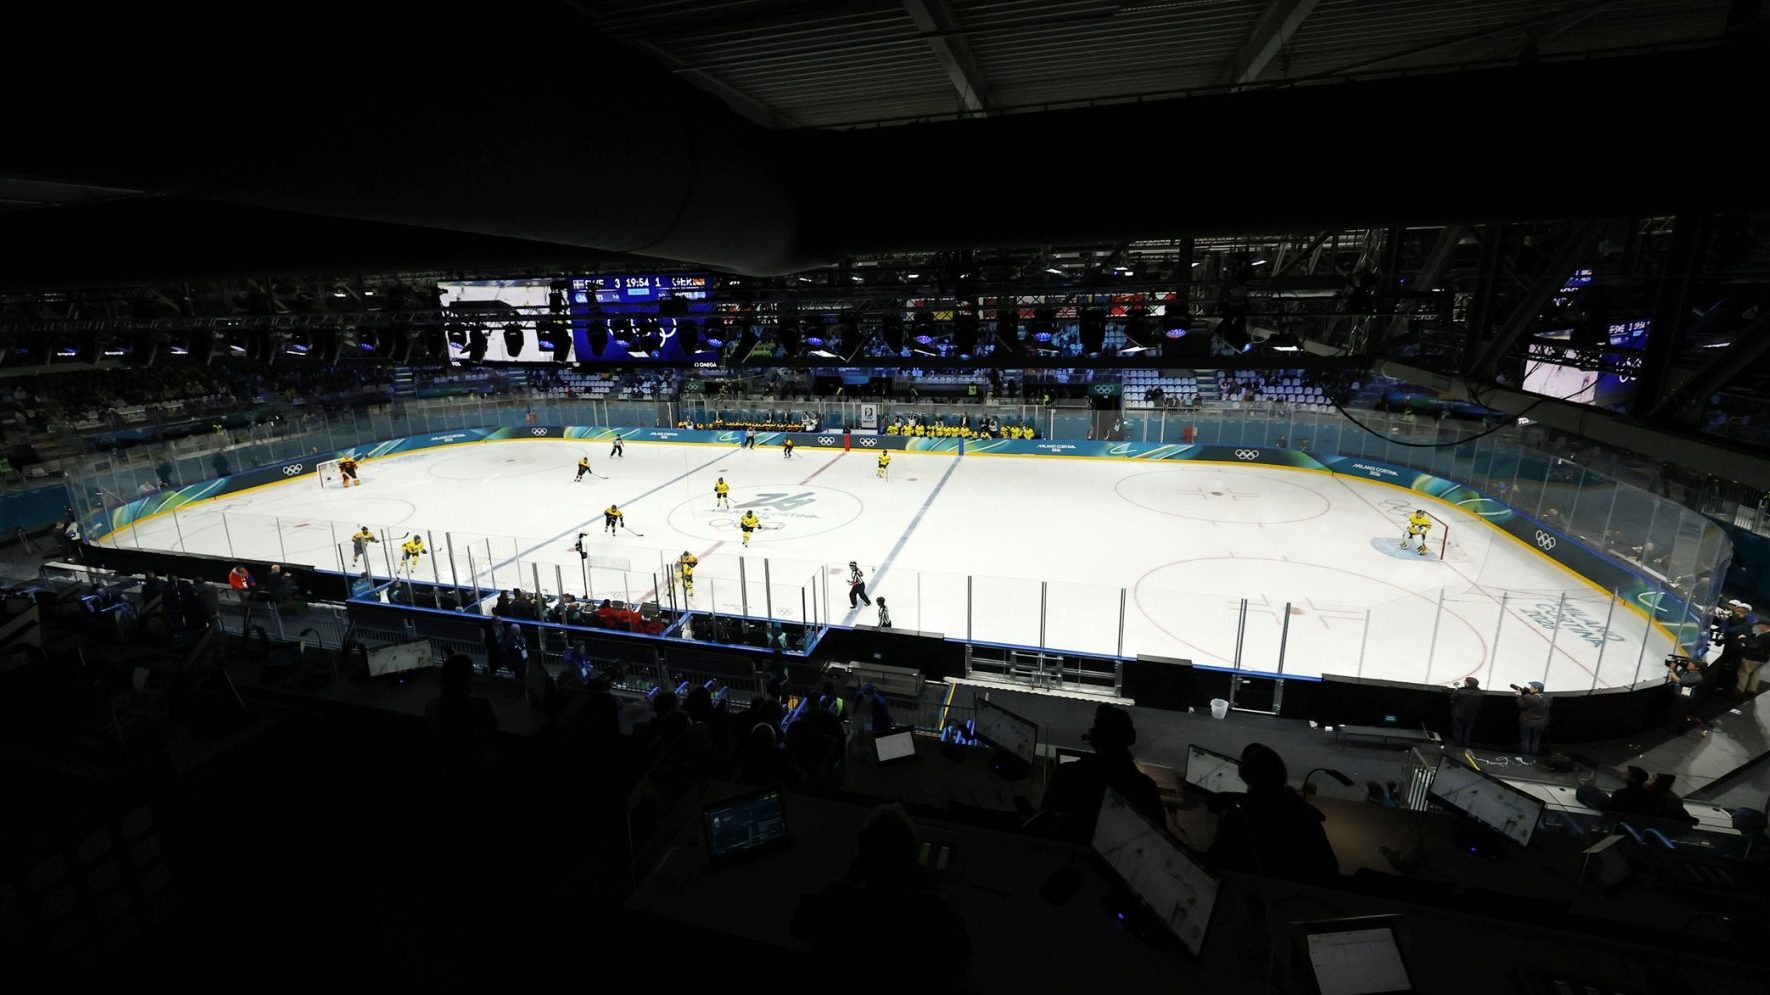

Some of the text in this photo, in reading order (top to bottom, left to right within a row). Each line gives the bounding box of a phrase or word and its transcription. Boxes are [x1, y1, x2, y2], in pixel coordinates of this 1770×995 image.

[615, 278, 621, 289] 3
[626, 277, 650, 288] 19:54
[655, 277, 661, 287] 1
[1376, 467, 1398, 476] CORTINA
